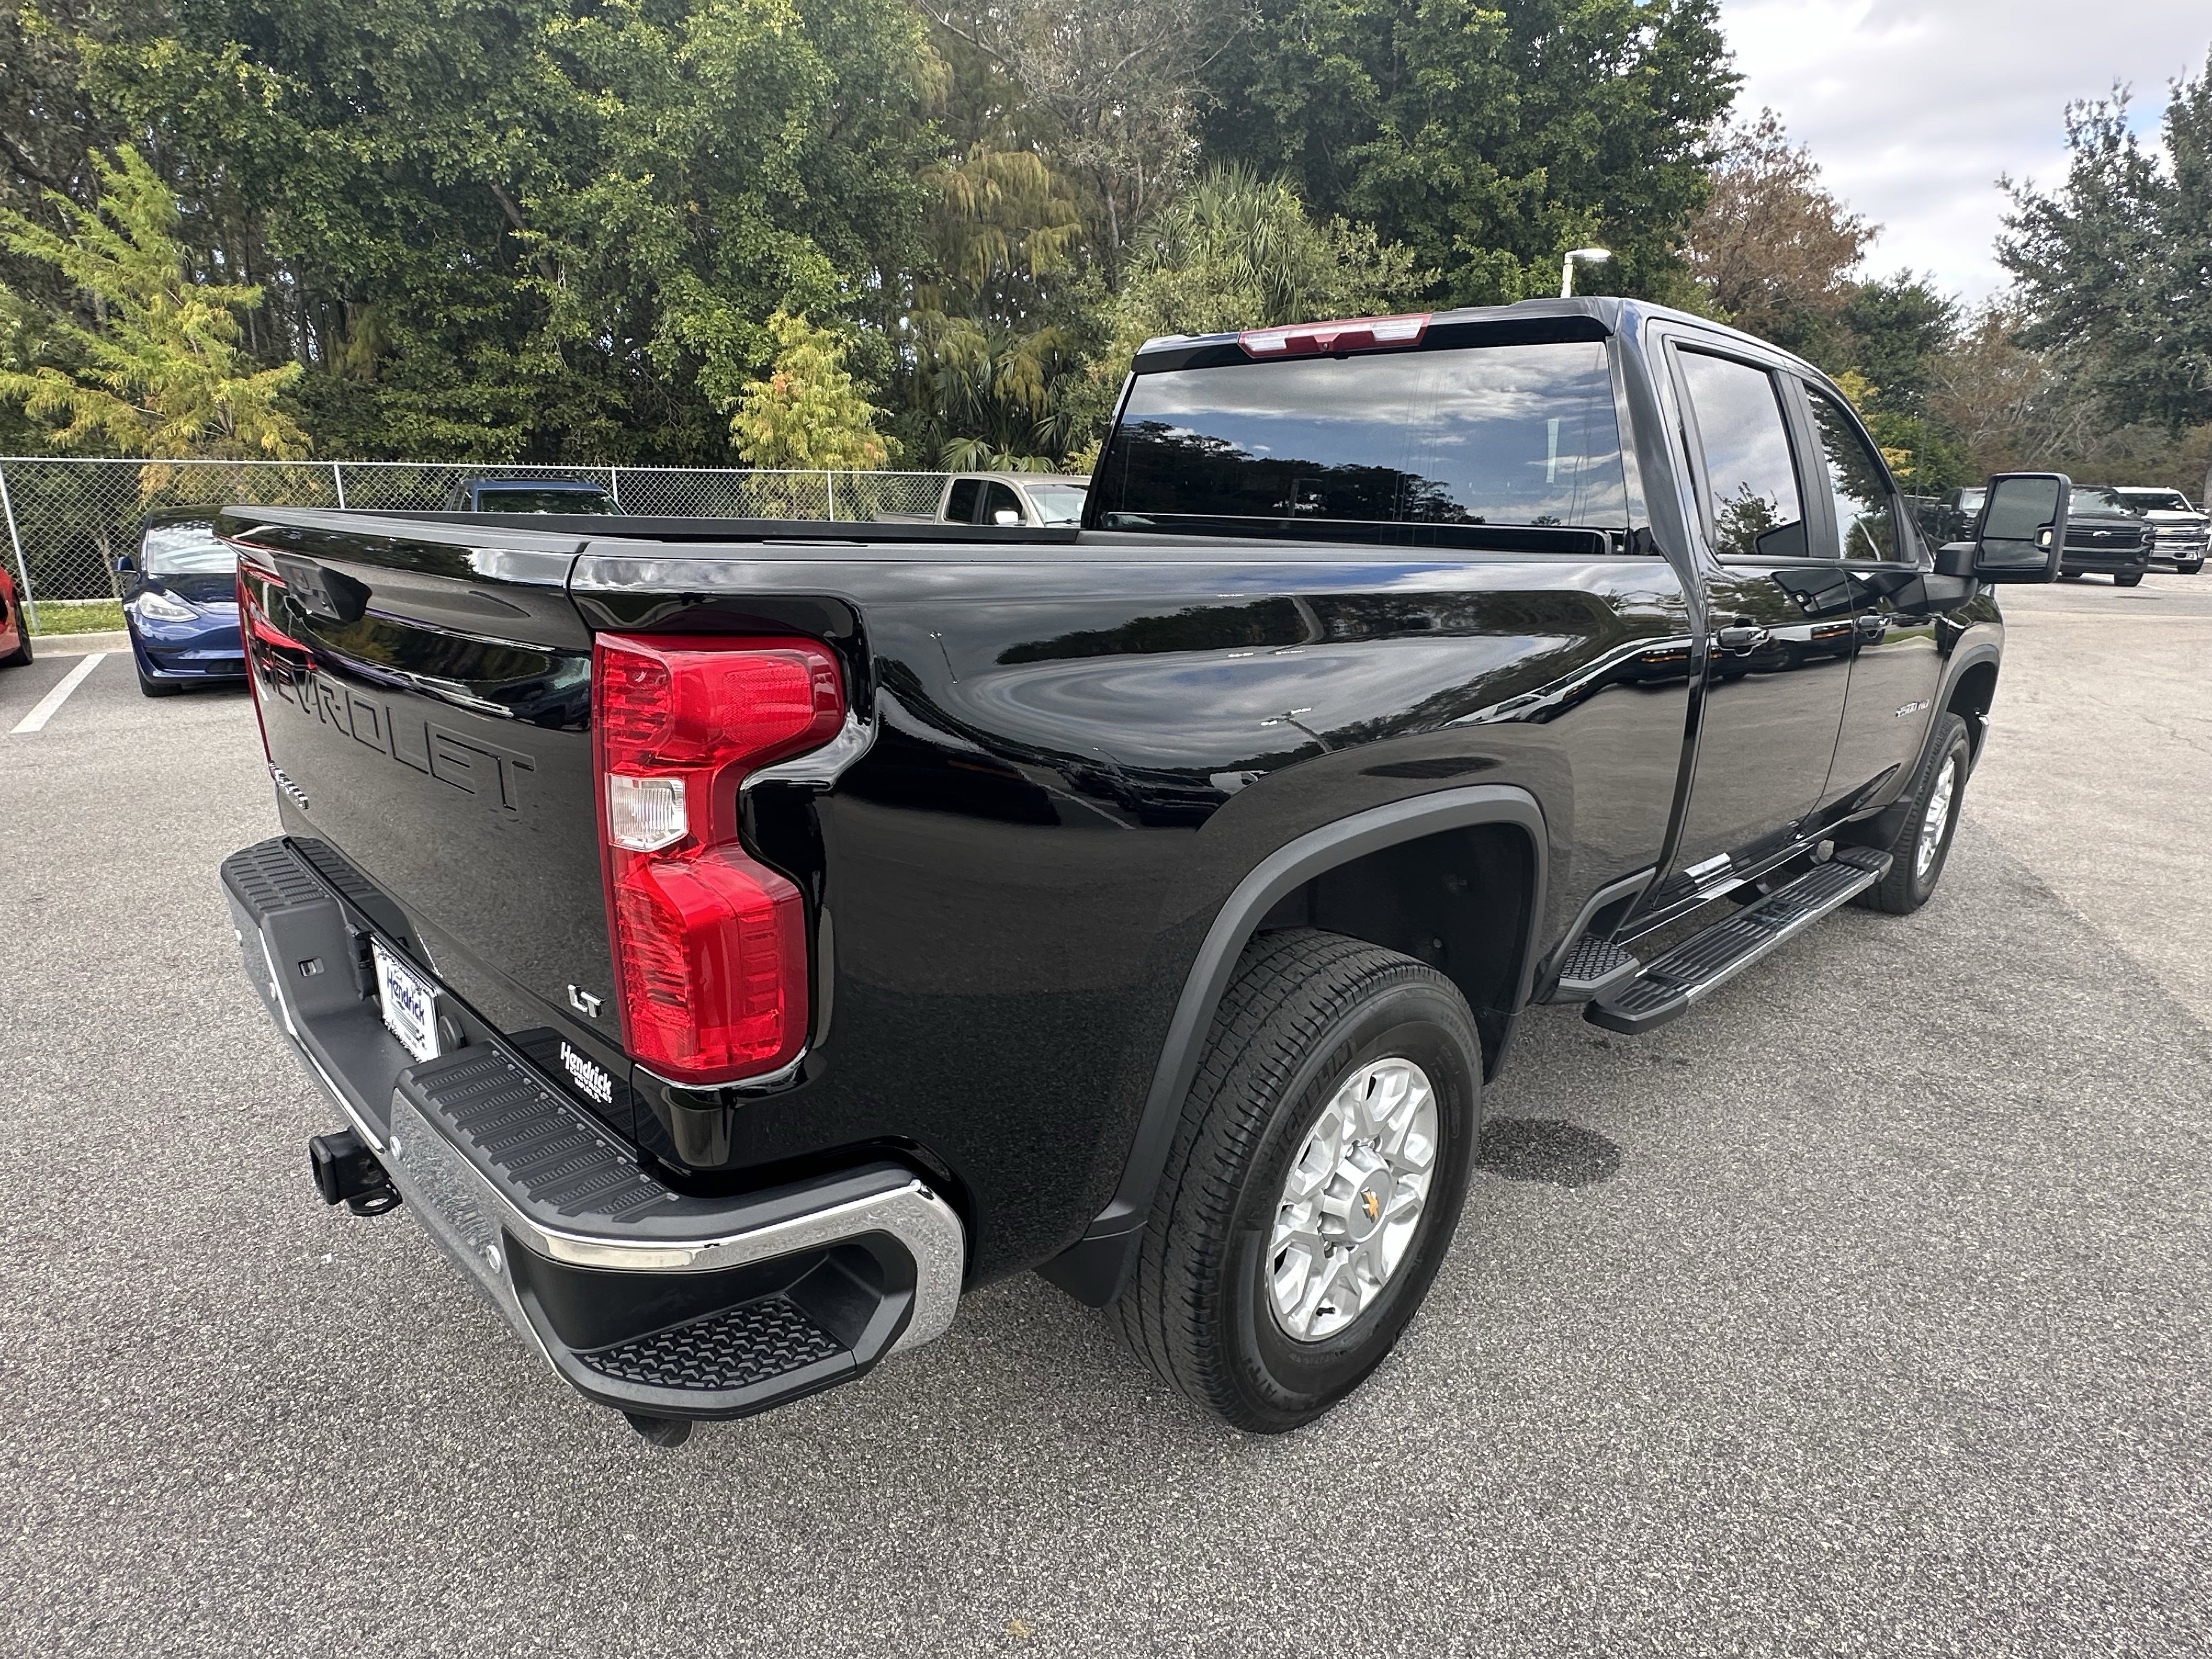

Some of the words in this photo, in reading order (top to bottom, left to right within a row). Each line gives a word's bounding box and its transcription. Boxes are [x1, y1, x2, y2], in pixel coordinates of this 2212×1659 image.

[386, 966, 425, 1026] Hendrick
[567, 984, 603, 1018] LT
[561, 1041, 612, 1096] Hendrick
